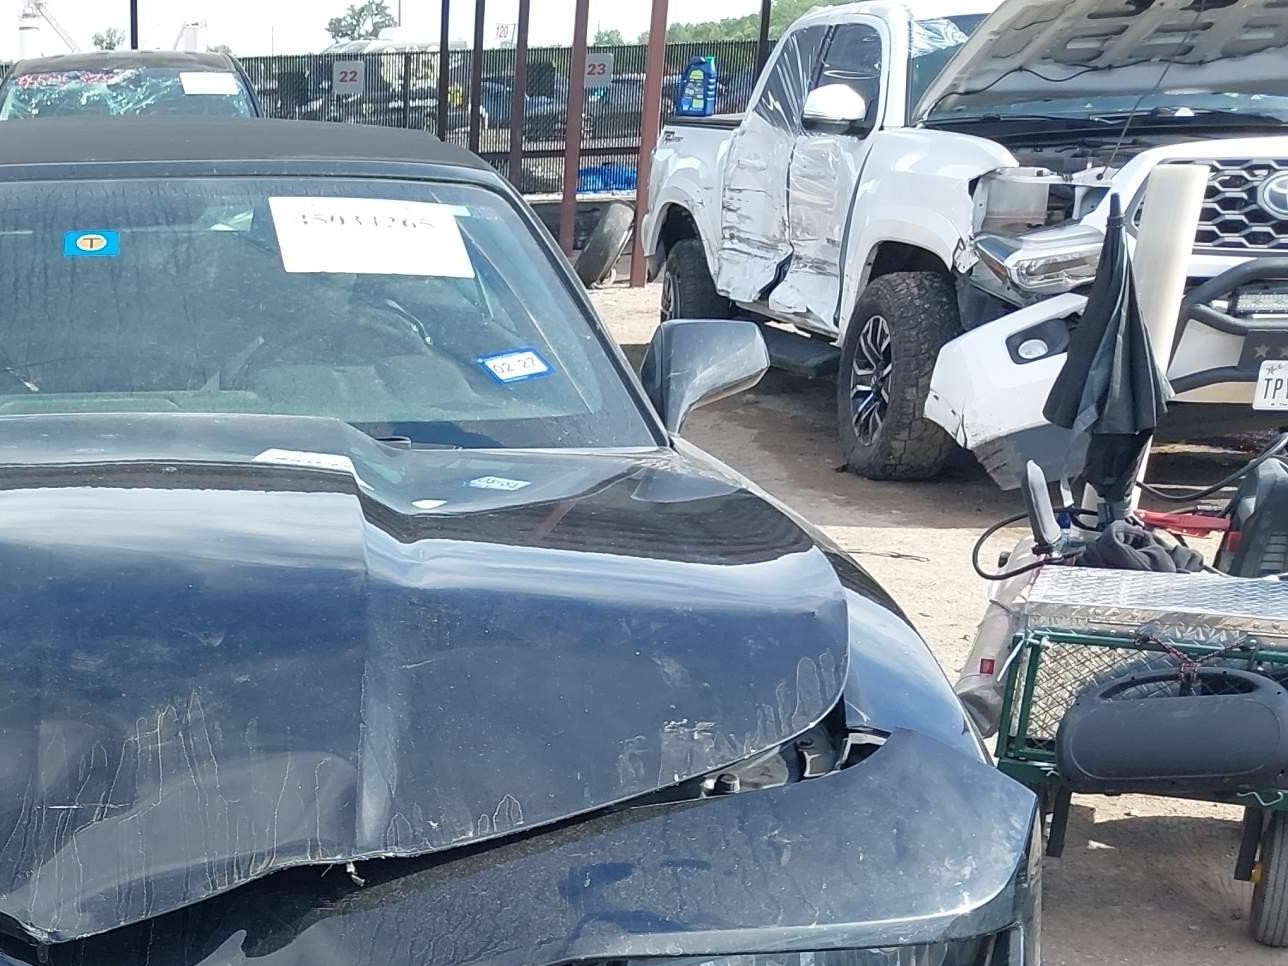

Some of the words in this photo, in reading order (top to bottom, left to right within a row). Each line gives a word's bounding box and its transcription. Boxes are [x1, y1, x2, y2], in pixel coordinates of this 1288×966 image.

[587, 63, 606, 76] 23
[339, 70, 358, 83] 22
[1263, 377, 1288, 400] TP
